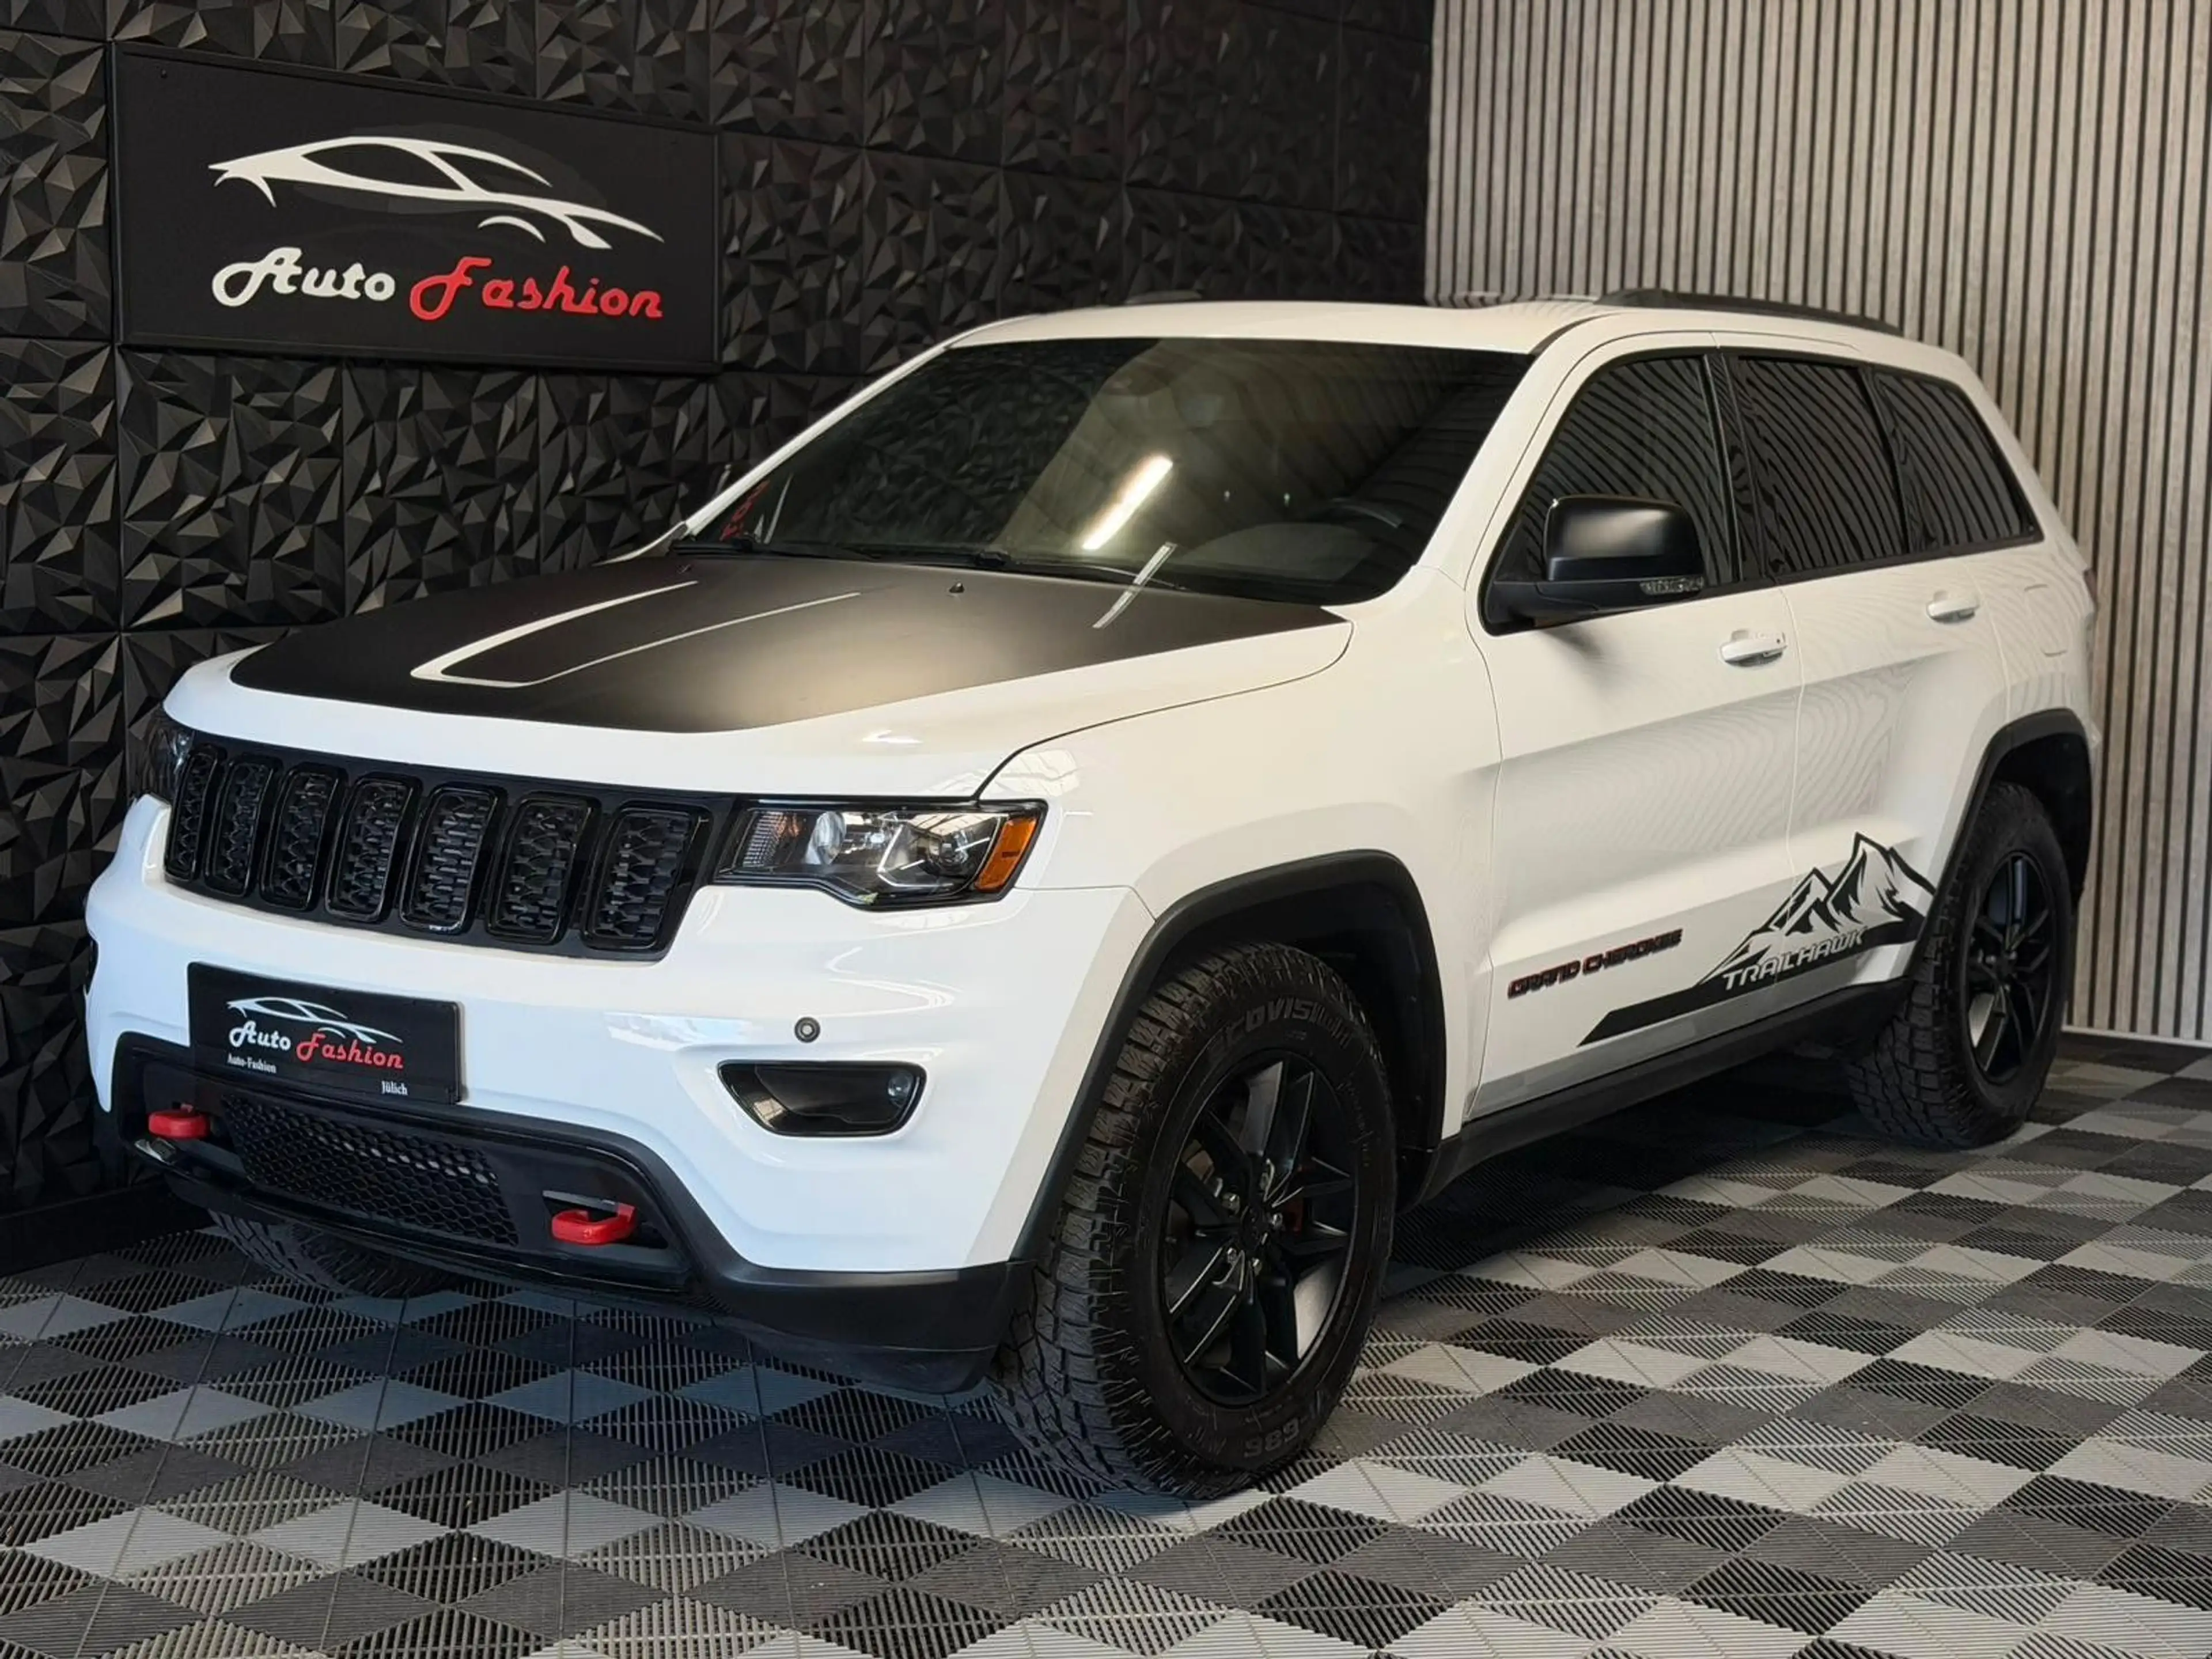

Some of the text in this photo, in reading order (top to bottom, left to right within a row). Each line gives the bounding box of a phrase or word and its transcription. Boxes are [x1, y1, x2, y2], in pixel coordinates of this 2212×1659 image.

[211, 246, 663, 321] Auto Fashion
[1508, 928, 1683, 999] GRAND CHEROKEE
[1722, 925, 1868, 991] TRAILHAWK
[227, 1052, 277, 1074] Auto-Fashion
[229, 1020, 404, 1069] Auto Fashion
[381, 1080, 408, 1096] Jülich
